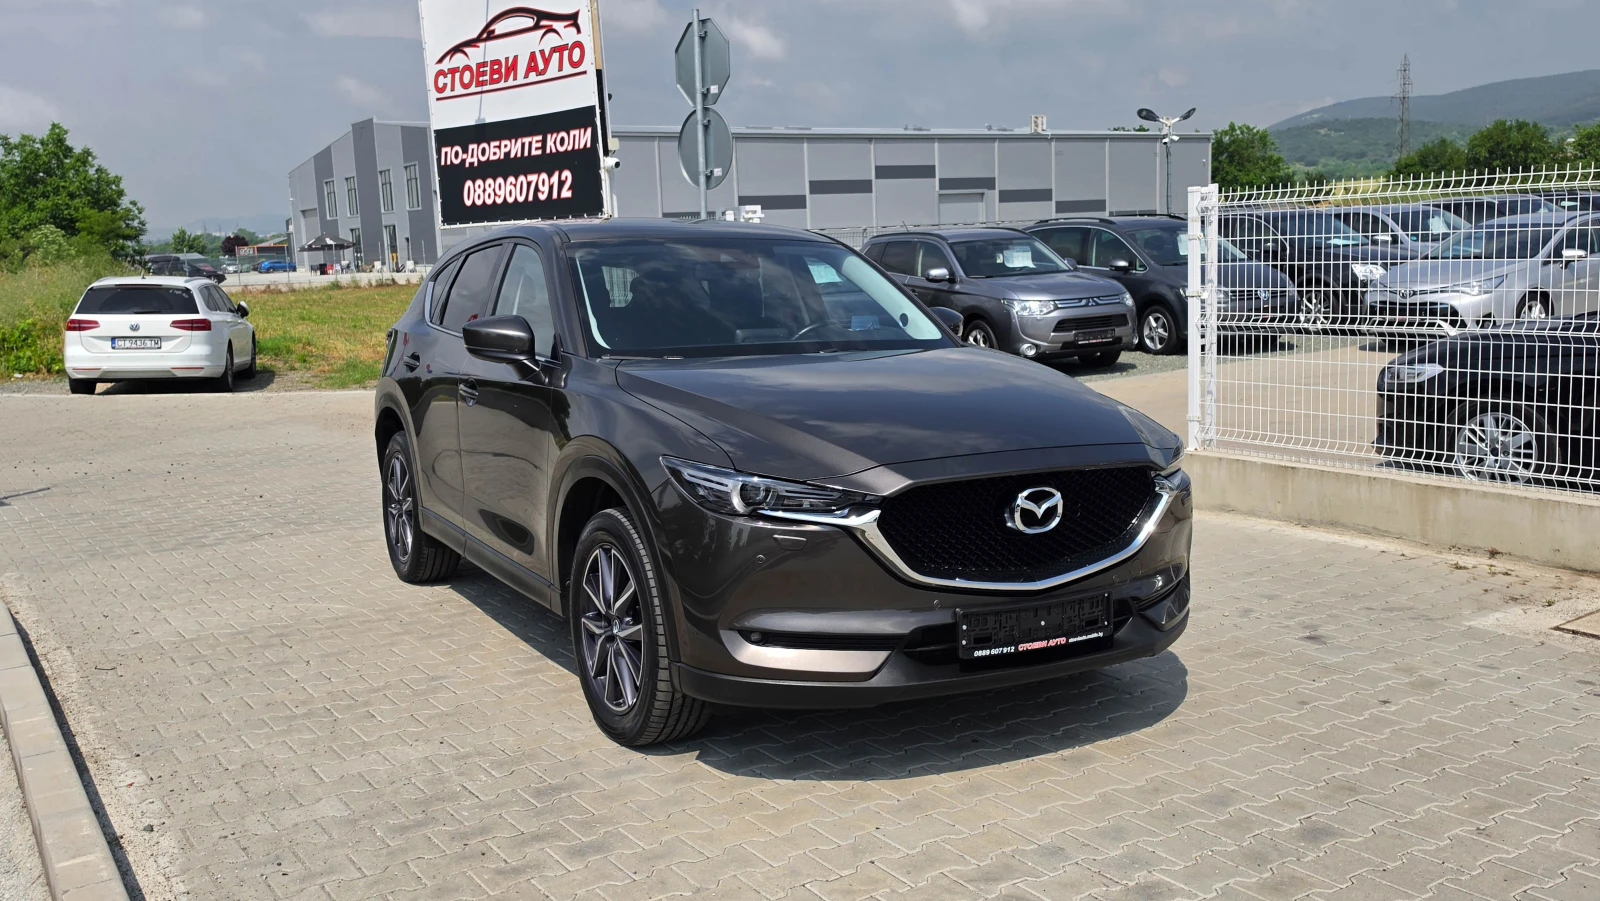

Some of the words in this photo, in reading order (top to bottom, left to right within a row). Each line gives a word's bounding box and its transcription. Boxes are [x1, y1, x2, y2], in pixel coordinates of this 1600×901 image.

[434, 55, 518, 94] СТОЕВИ
[523, 40, 586, 80] АУТО
[440, 135, 543, 168] ПО-ДОБРИТЕ
[545, 127, 592, 154] КОЛИ
[463, 169, 573, 207] 0889607912
[128, 339, 148, 347] 9436
[973, 649, 990, 657] 0889
[990, 647, 1002, 655] 607
[1002, 646, 1015, 654] 912
